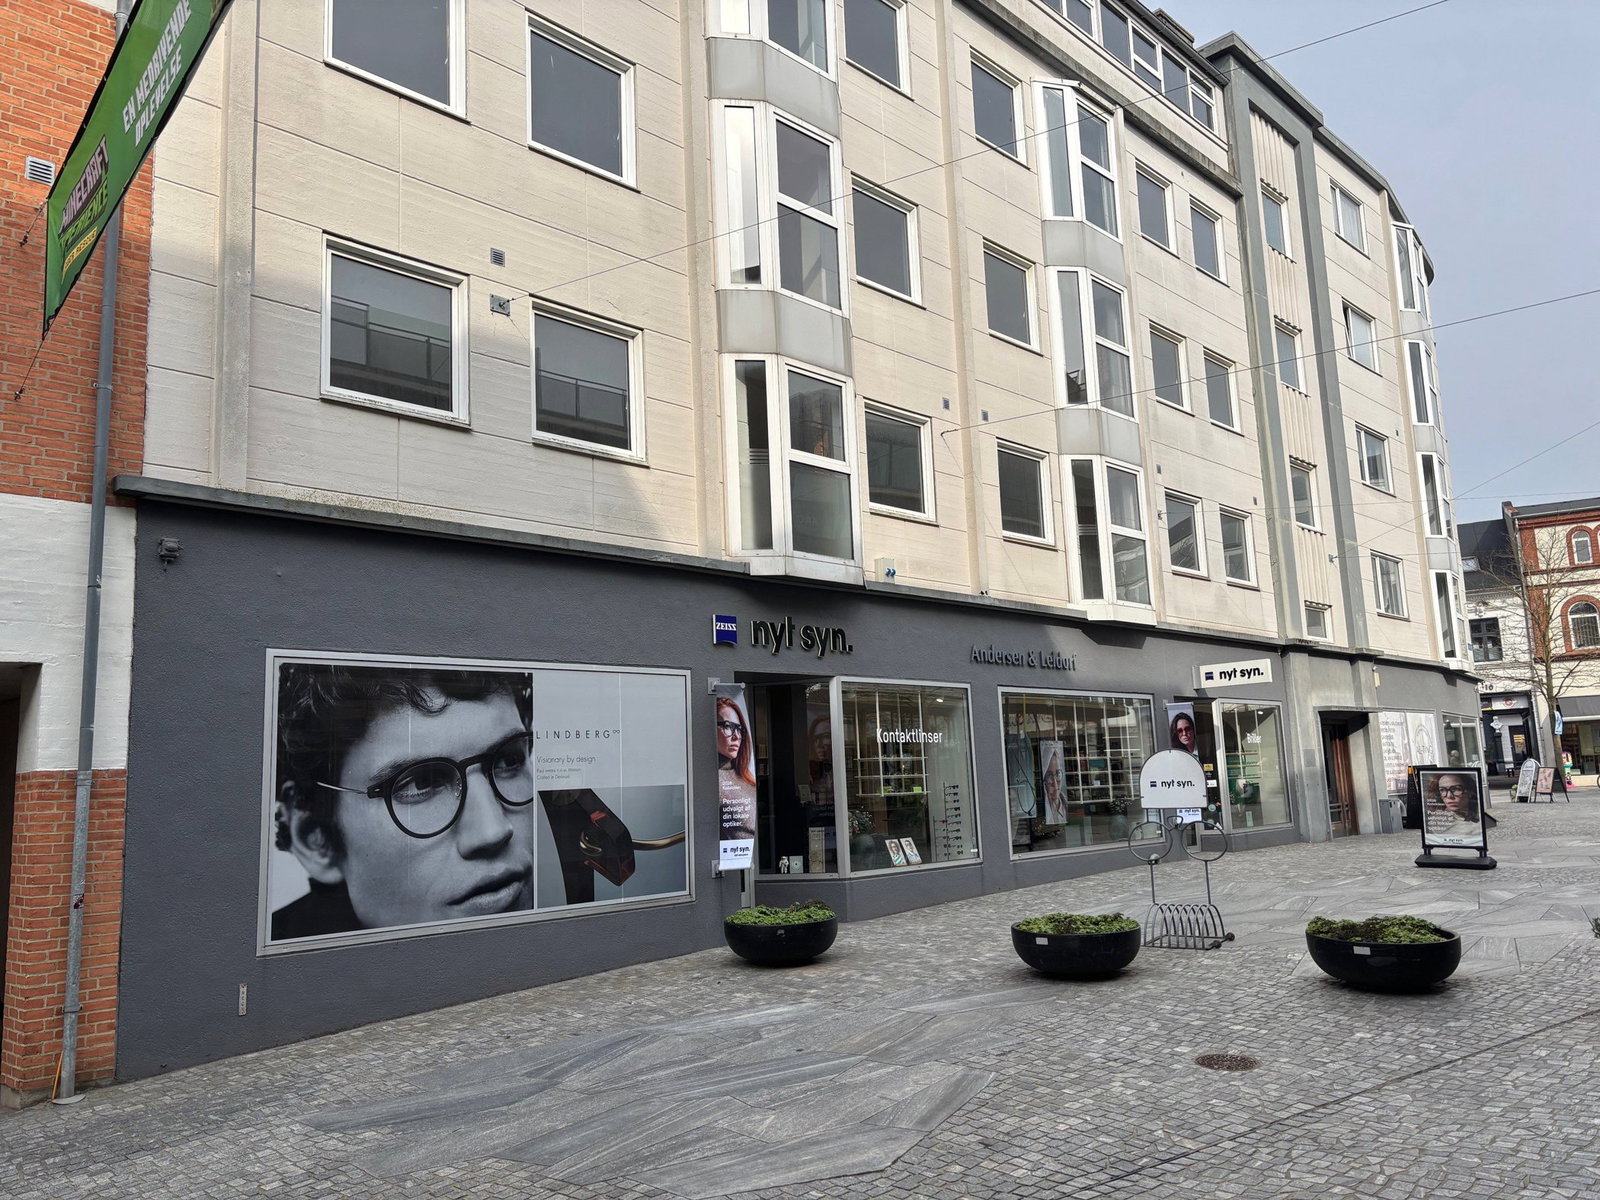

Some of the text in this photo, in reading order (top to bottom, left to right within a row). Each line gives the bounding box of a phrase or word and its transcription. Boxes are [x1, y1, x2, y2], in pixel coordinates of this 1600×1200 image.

[715, 622, 737, 631] ZEISS
[750, 616, 853, 658] nyt syn.
[970, 644, 1024, 667] Andersen
[1027, 650, 1038, 668] &
[1219, 667, 1264, 681] nyt syn.
[536, 730, 611, 739] LINDBERG
[876, 728, 943, 743] Kontaktlinser
[536, 755, 596, 765] Visionary by design
[1161, 779, 1195, 789] nyt syn.
[722, 805, 744, 813] udvalgt
